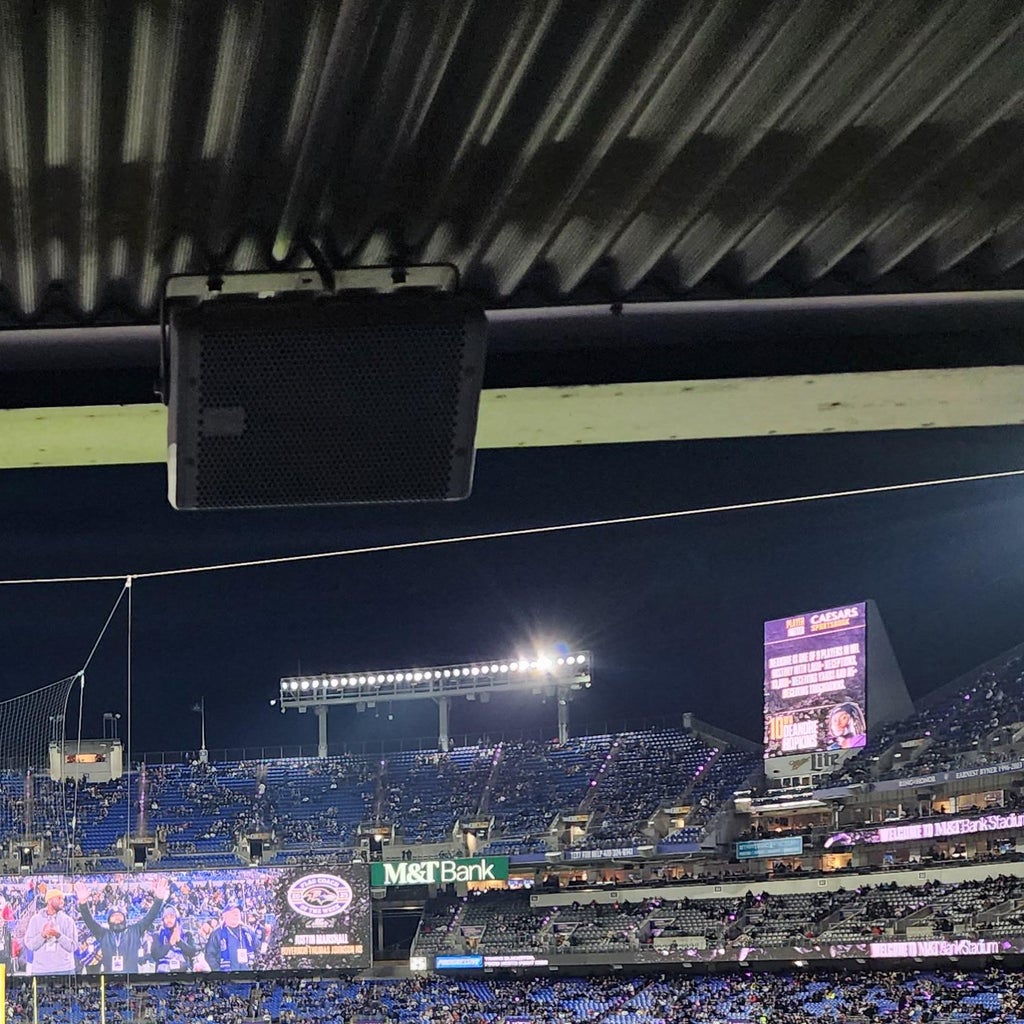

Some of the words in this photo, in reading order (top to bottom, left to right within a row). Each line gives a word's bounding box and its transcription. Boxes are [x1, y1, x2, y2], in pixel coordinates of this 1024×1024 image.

[811, 607, 858, 624] CAESARS
[960, 818, 986, 834] Bank
[383, 861, 439, 885] M&T
[441, 859, 495, 882] Bank
[961, 940, 999, 955] Stadium
